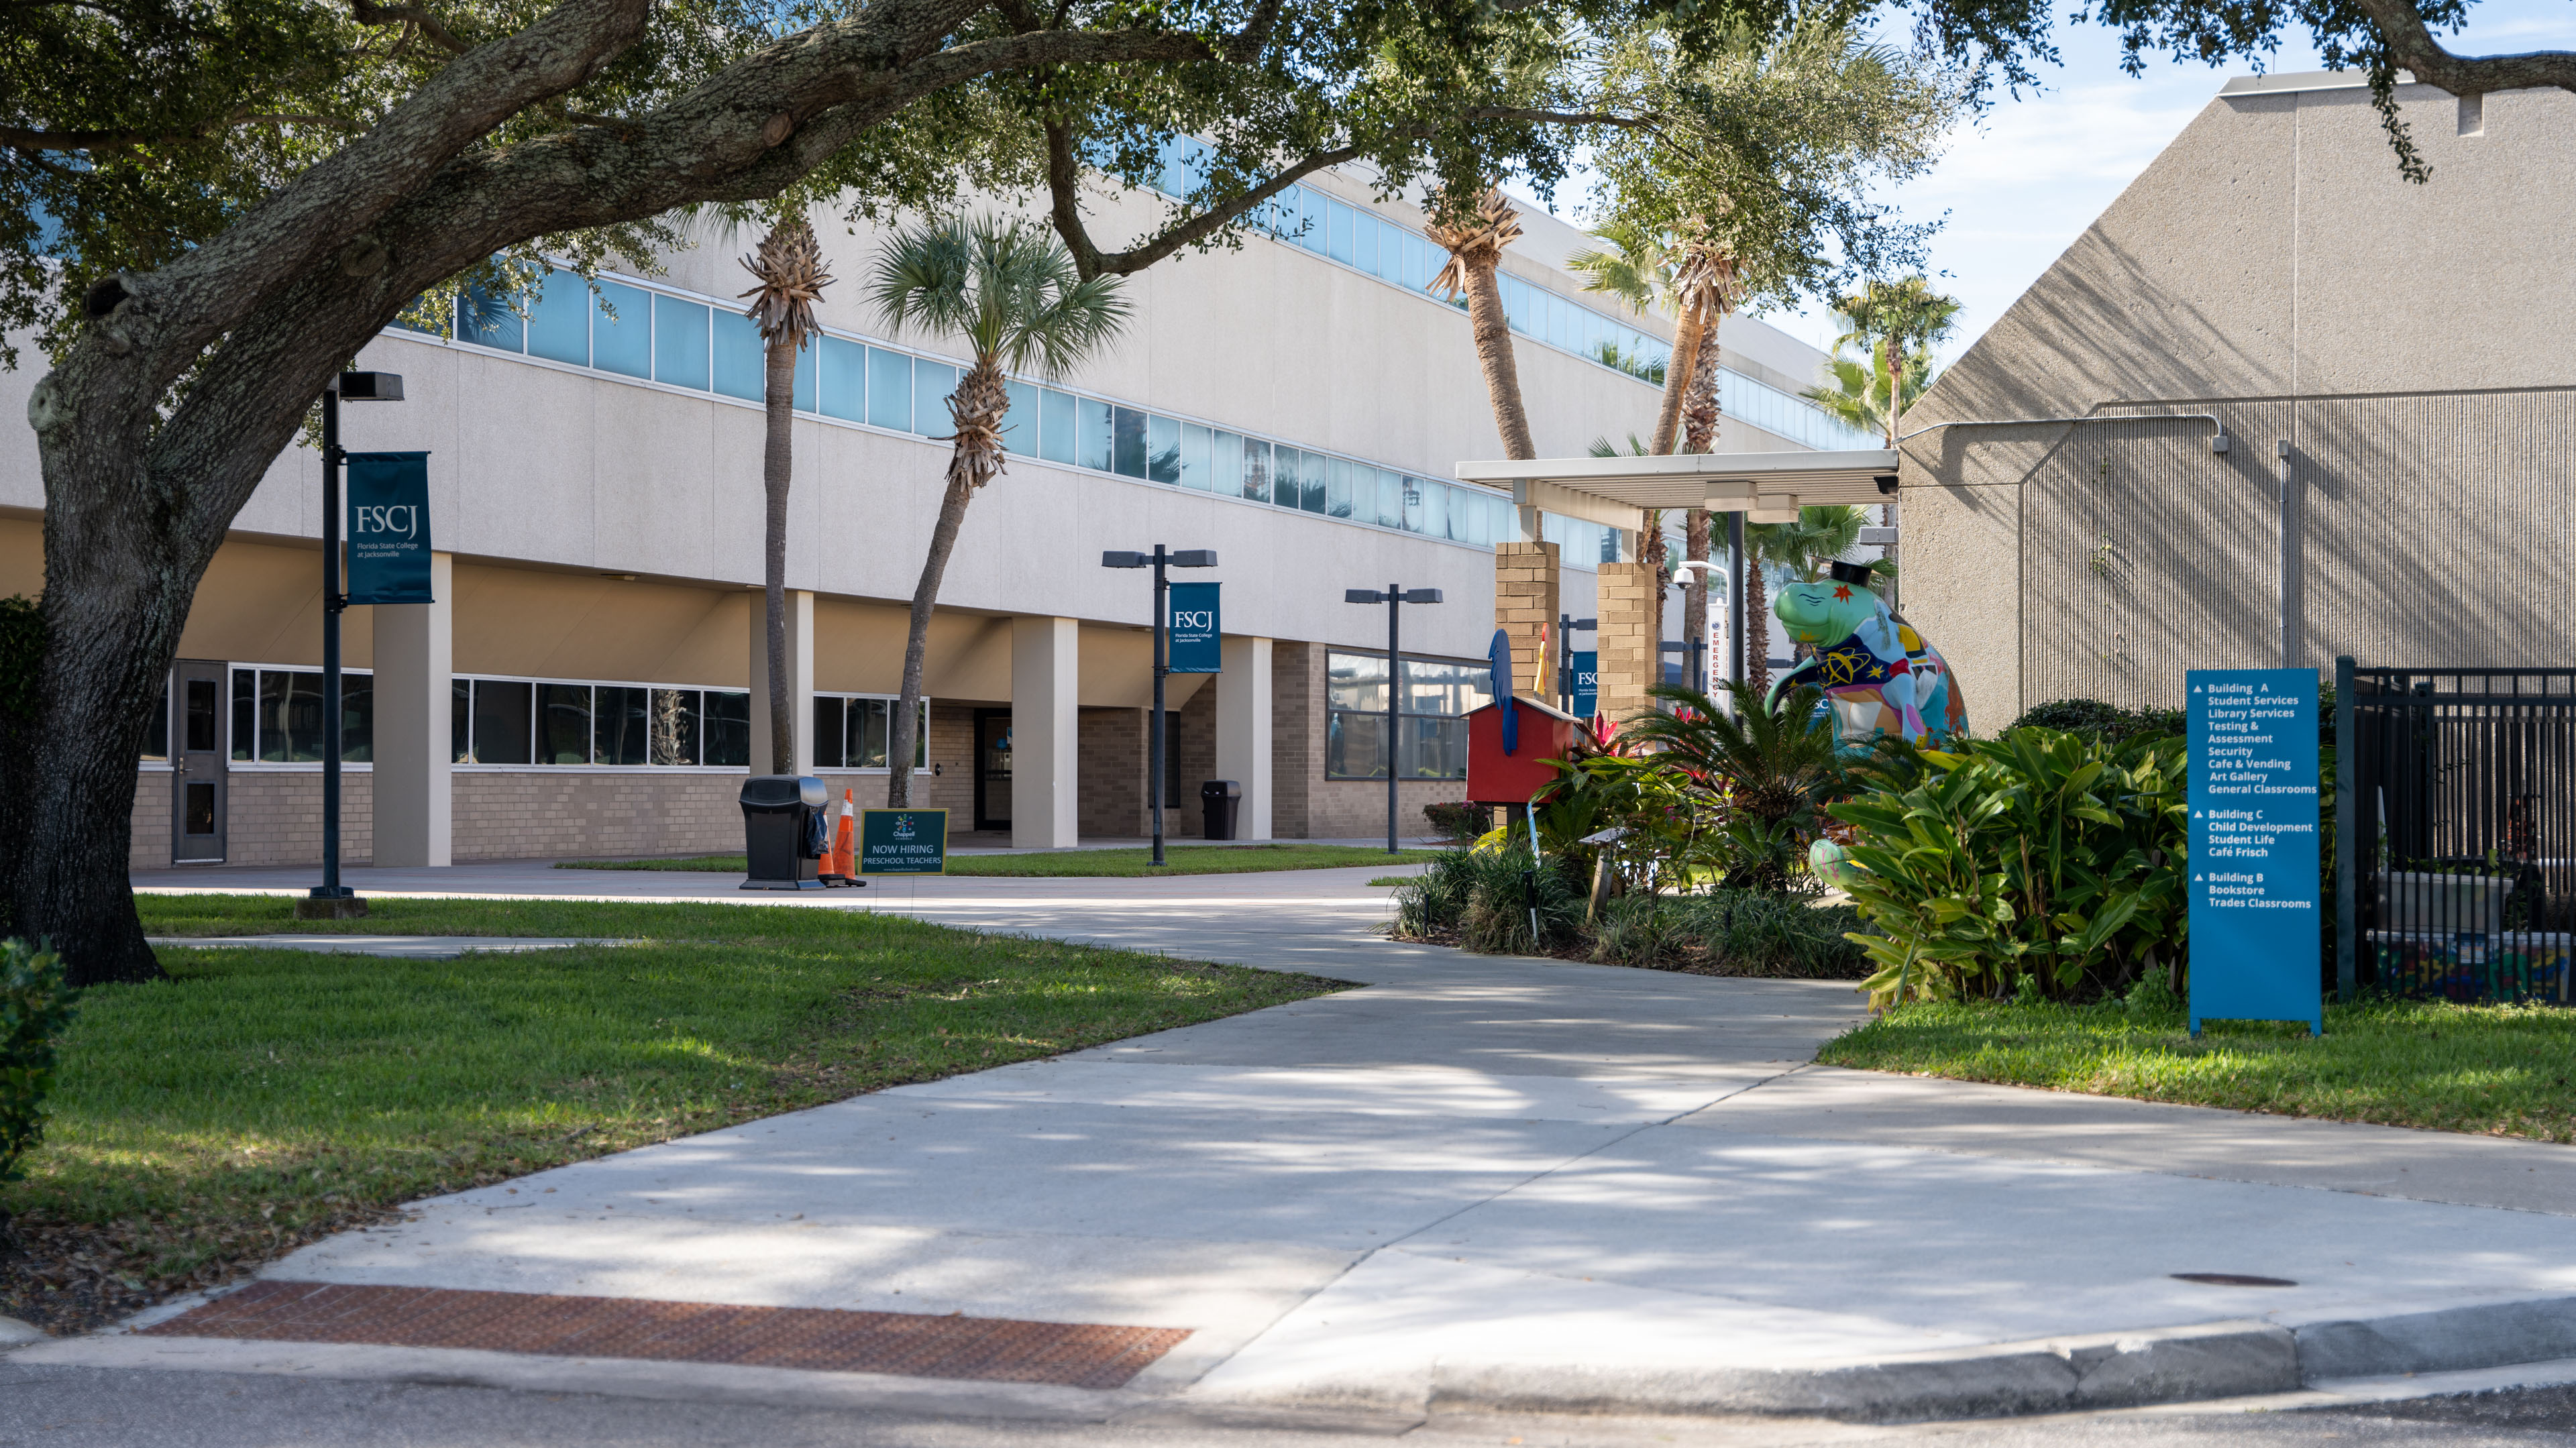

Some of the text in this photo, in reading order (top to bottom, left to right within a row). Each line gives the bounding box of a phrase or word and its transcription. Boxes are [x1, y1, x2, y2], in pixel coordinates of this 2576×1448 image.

[355, 505, 418, 540] FSCJ
[396, 542, 419, 550] College
[364, 551, 400, 559] Jacksonville
[1174, 611, 1213, 632] FSCJ
[1578, 672, 1597, 685] FSC
[2208, 683, 2269, 694] Building A
[2208, 695, 2299, 706] Student Services
[2208, 709, 2294, 720] Library Services
[2208, 722, 2259, 732] Testing &
[2208, 734, 2273, 743] Assessment
[2208, 747, 2253, 757] Security
[2208, 759, 2291, 771] Cafe & Vending
[2210, 772, 2267, 783] Art Gallery
[2208, 784, 2317, 793] General Classrooms
[2209, 810, 2263, 821] Building C
[2209, 822, 2313, 834] Child Development
[2209, 834, 2275, 844] Student Life
[873, 845, 934, 854] NOW HIRING
[2209, 846, 2268, 857] Café Frisch
[2209, 873, 2263, 884] Building B
[2209, 885, 2265, 895] Bookstore
[2209, 898, 2311, 908] Trades Classrooms
